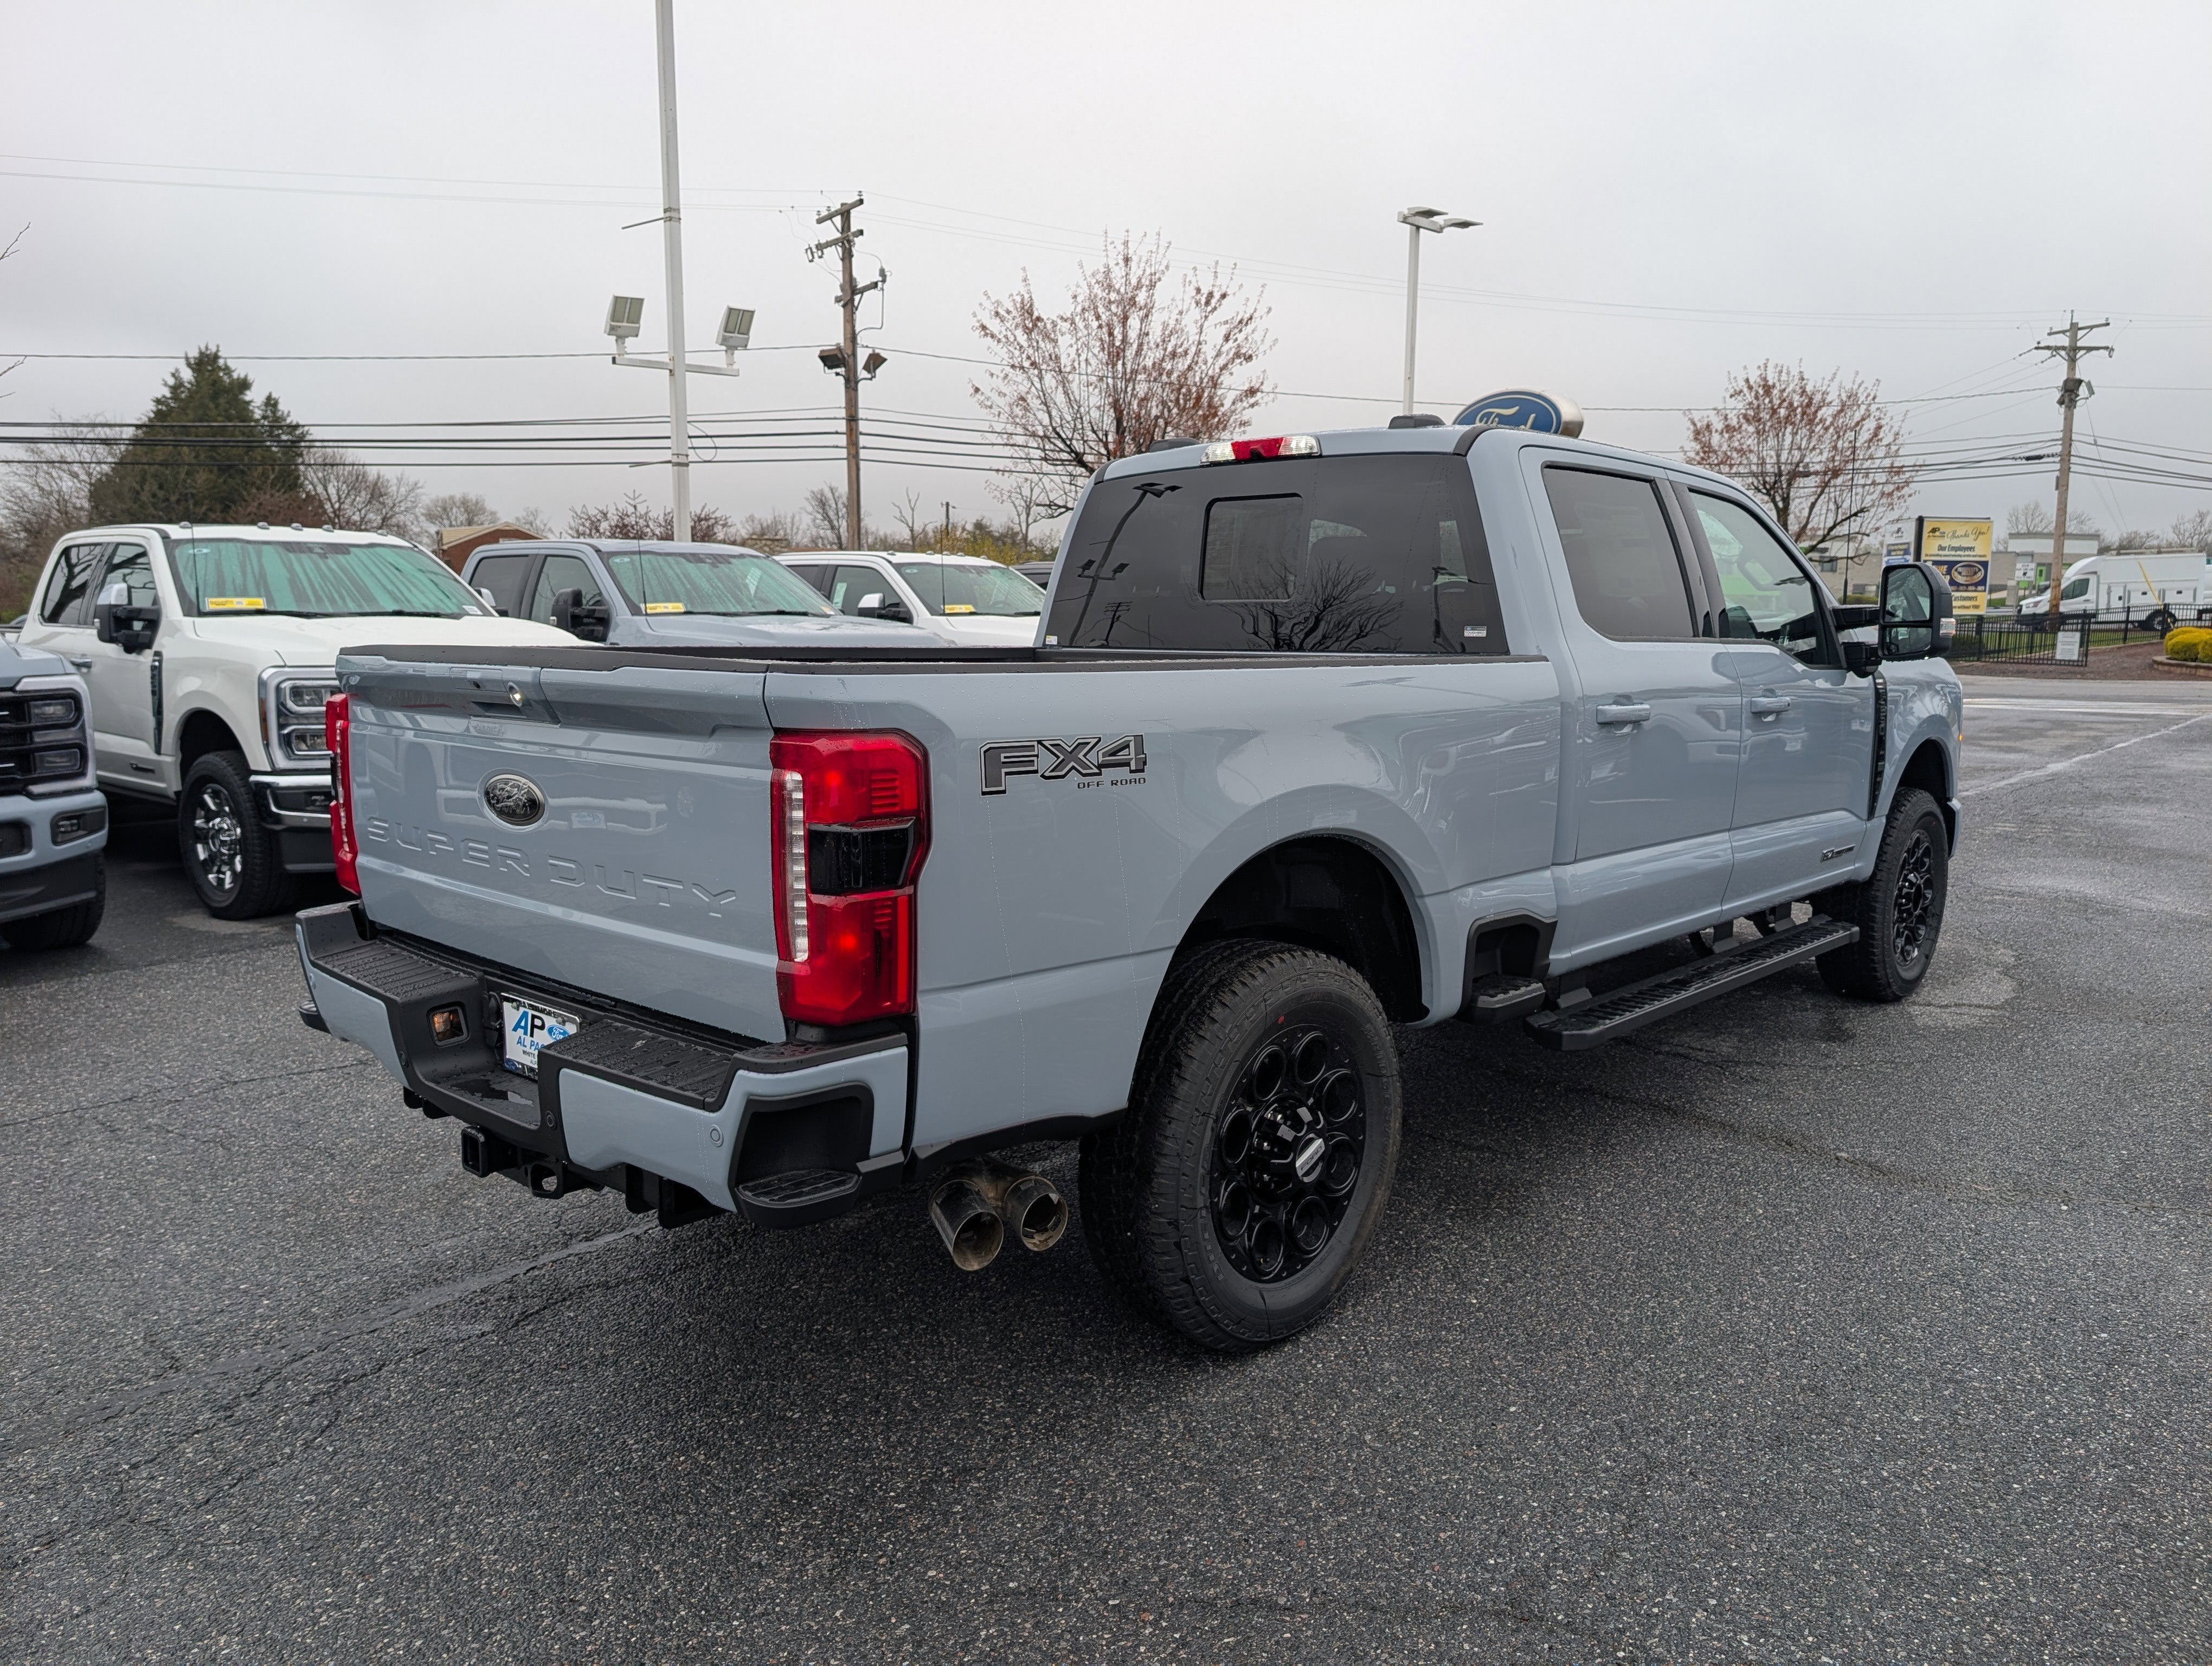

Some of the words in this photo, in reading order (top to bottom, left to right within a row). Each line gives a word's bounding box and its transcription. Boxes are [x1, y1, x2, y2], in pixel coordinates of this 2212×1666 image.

[1947, 544, 1976, 552] Employees
[979, 734, 1147, 796] FX4
[1077, 780, 1105, 790] OFF
[1111, 777, 1146, 787] ROAD
[368, 816, 530, 876] SUPER
[548, 855, 736, 917] DUTY
[511, 1009, 546, 1039] AP
[516, 1035, 527, 1048] AL
[522, 1049, 536, 1059] WHITE
[1300, 1145, 1323, 1171] FORD
